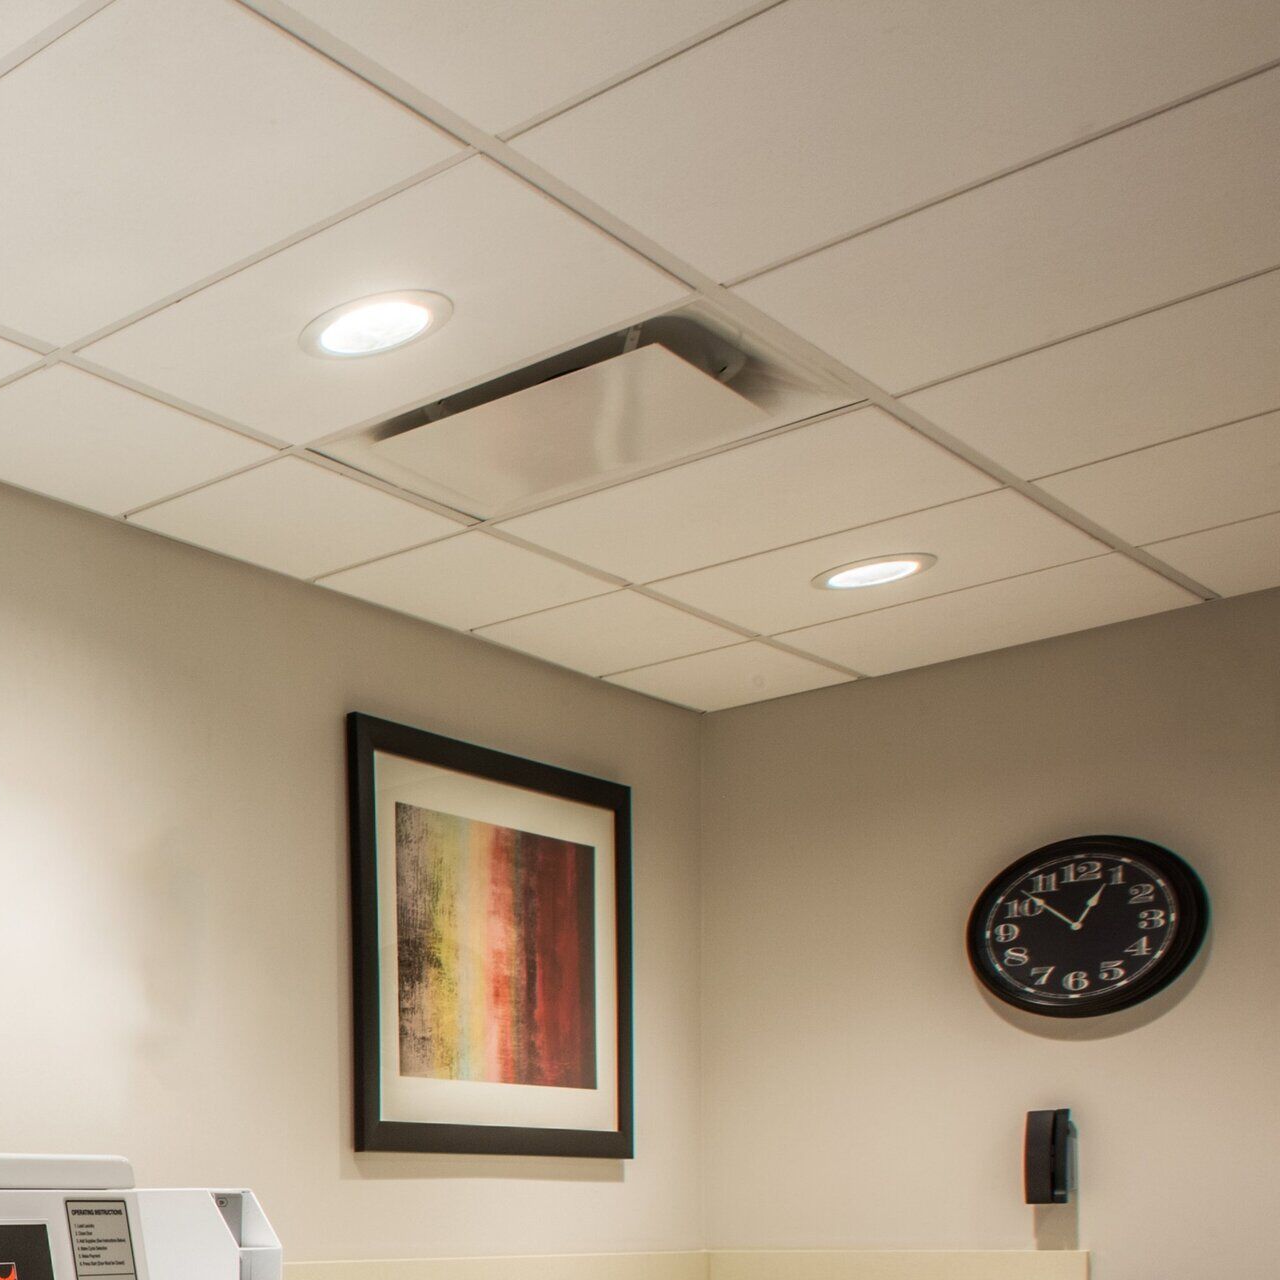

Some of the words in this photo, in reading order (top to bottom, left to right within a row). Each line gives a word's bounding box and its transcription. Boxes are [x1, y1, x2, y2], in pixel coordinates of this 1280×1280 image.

[1061, 861, 1103, 883] 12
[1107, 865, 1126, 885] 1
[1031, 872, 1060, 893] 11
[1128, 884, 1155, 904] 2
[1004, 899, 1044, 918] 10
[1139, 909, 1165, 929] 3
[995, 923, 1020, 943] 9
[1124, 936, 1152, 956] 4
[1004, 947, 1029, 966] 8
[1031, 966, 1055, 985] 7
[1099, 960, 1126, 980] 5
[1063, 971, 1089, 990] 6
